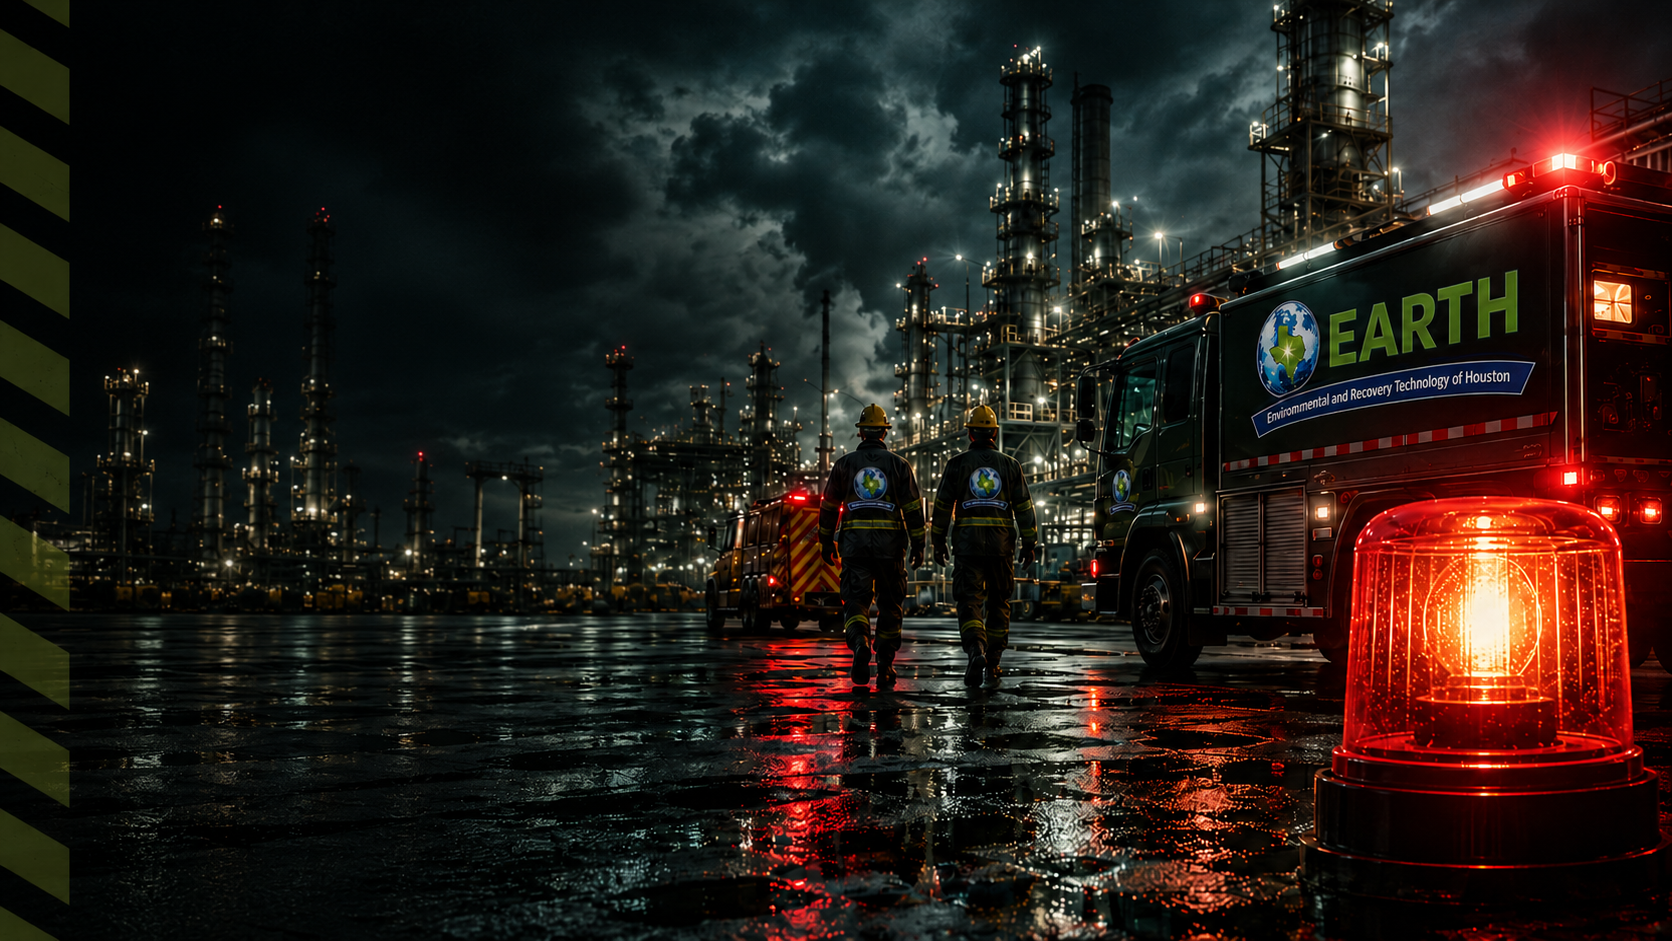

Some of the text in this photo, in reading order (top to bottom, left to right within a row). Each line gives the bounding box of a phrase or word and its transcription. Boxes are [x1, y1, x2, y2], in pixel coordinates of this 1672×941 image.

[1329, 269, 1519, 368] EARTH
[1331, 389, 1348, 405] and
[1350, 384, 1393, 401] Recovery
[1394, 374, 1450, 392] Technology
[1452, 370, 1464, 385] of
[1465, 370, 1511, 384] Houston
